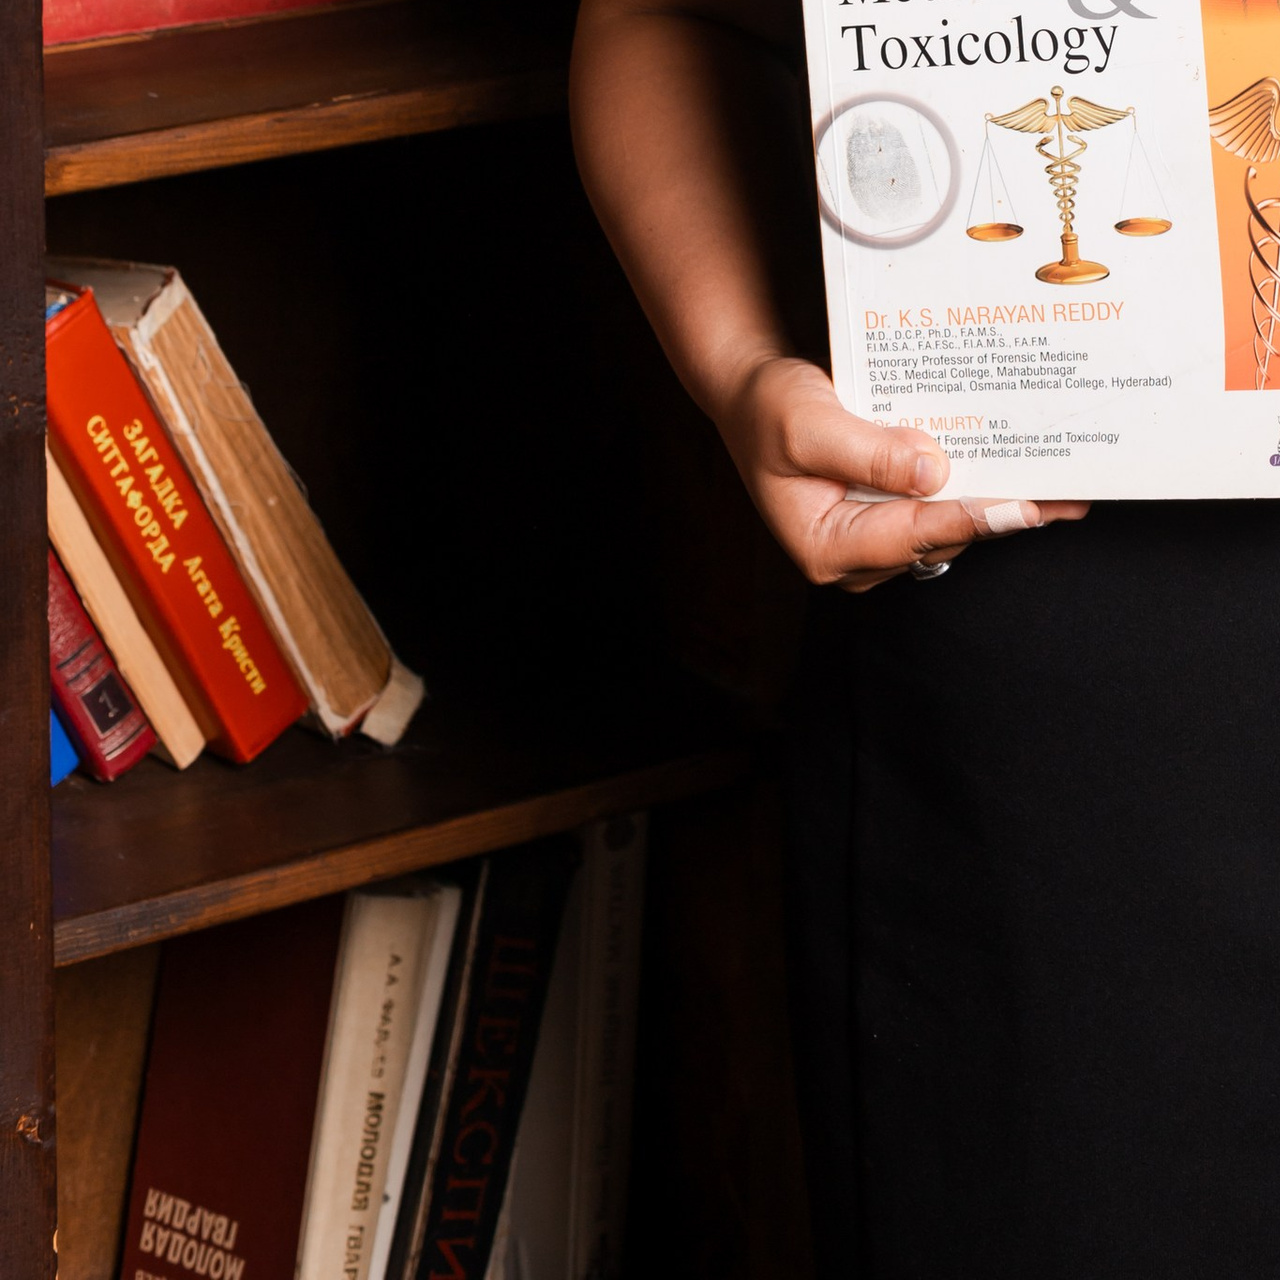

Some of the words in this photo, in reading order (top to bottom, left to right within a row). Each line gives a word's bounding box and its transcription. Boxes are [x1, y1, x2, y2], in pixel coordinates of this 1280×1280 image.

[840, 14, 1119, 75] Toxicology
[865, 310, 892, 330] Dr.
[898, 307, 940, 329] K.S.
[947, 304, 1046, 327] NARAYAN
[1052, 301, 1125, 323] REDDY
[867, 357, 919, 369] Honorary
[922, 354, 974, 366] Professor
[977, 353, 988, 364] of
[991, 352, 1037, 364] Forensic
[1039, 350, 1089, 362] Medicine
[869, 370, 901, 382] S.V.S.
[904, 369, 947, 380] Medical
[950, 367, 994, 380] College,
[996, 365, 1077, 378] Mahabubnagar
[870, 383, 913, 397] (Retired
[916, 382, 966, 395] Principal,
[969, 379, 1017, 392] Osmania
[1020, 378, 1062, 390] Medical
[1065, 377, 1108, 391] College,
[1111, 375, 1173, 389] Hyderabad)
[872, 402, 892, 413] and
[929, 415, 985, 431] MURTY
[988, 419, 1012, 430] M.D.
[944, 434, 990, 446] Forensic
[992, 432, 1040, 444] Medicine
[1042, 432, 1062, 443] and
[1065, 431, 1120, 445] Toxicology
[967, 447, 979, 459] of
[981, 446, 1022, 458] Medical
[1024, 446, 1071, 457] Sciences
[122, 417, 190, 531] ЗАГАДКА
[85, 413, 178, 574] СИТТАФОРДА
[182, 555, 225, 620] Агата
[218, 616, 268, 696] Кристи
[142, 1186, 241, 1251] ГВАРДИЯ
[138, 1219, 247, 1280] МОЛОДАЯ
